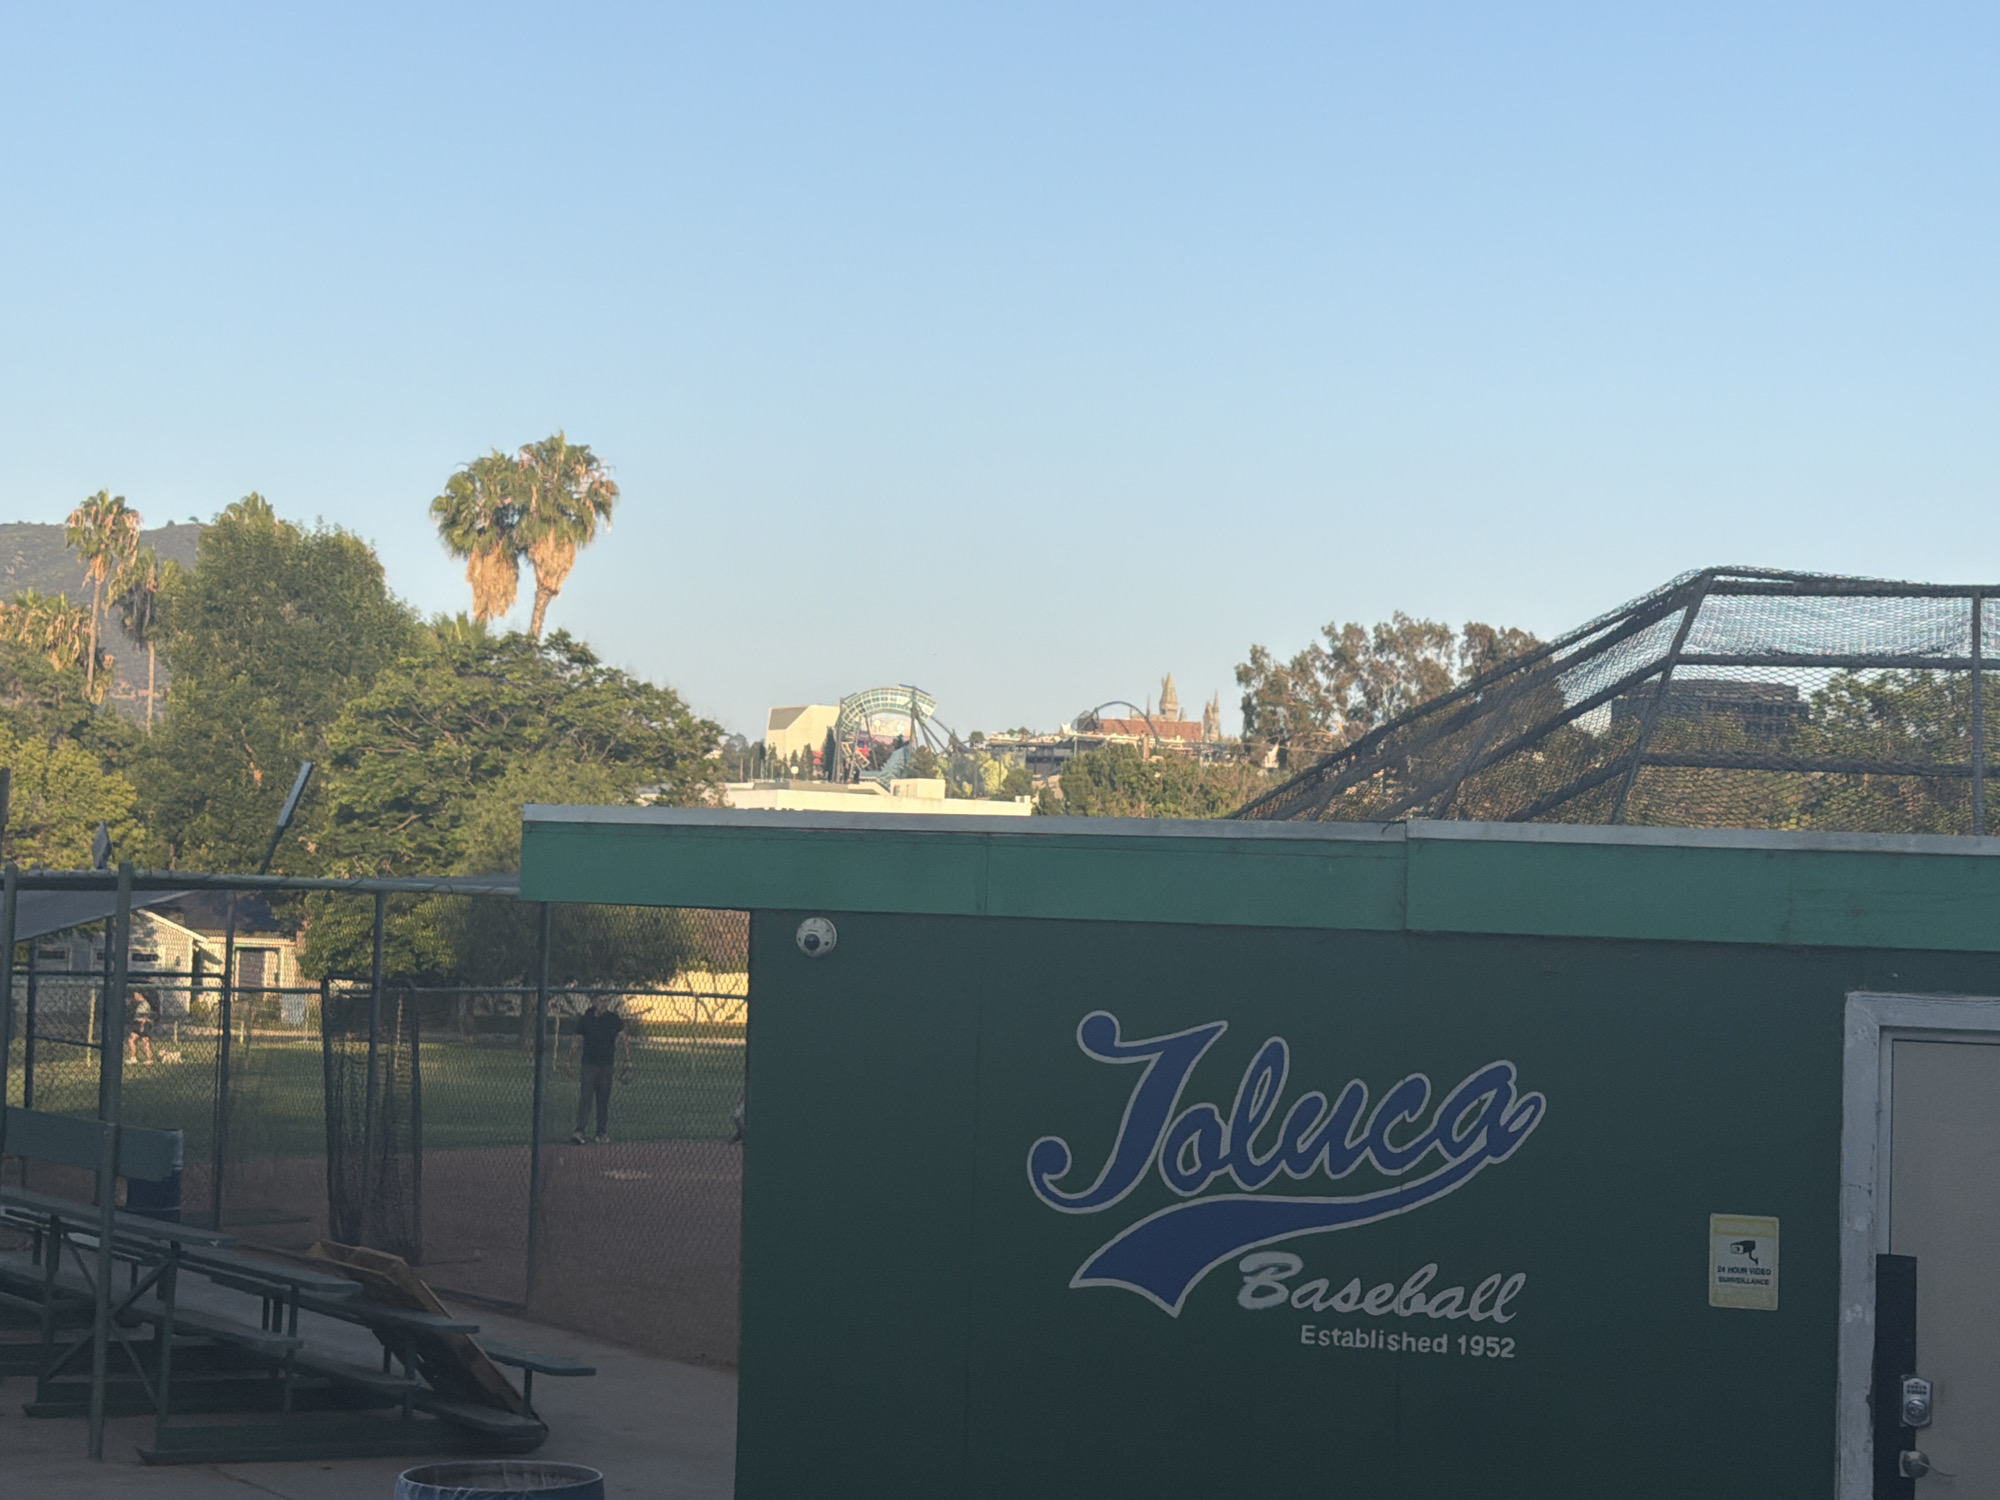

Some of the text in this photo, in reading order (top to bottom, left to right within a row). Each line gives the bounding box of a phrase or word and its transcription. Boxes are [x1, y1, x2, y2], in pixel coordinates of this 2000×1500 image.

[1026, 1009, 1547, 1215] Toluca
[1236, 1251, 1527, 1325] Baseball
[1717, 1265, 1726, 1273] 24
[1749, 1268, 1771, 1276] VIDEO
[1718, 1277, 1769, 1285] SURVEILLANCE
[1300, 1324, 1516, 1359] Established 1952
